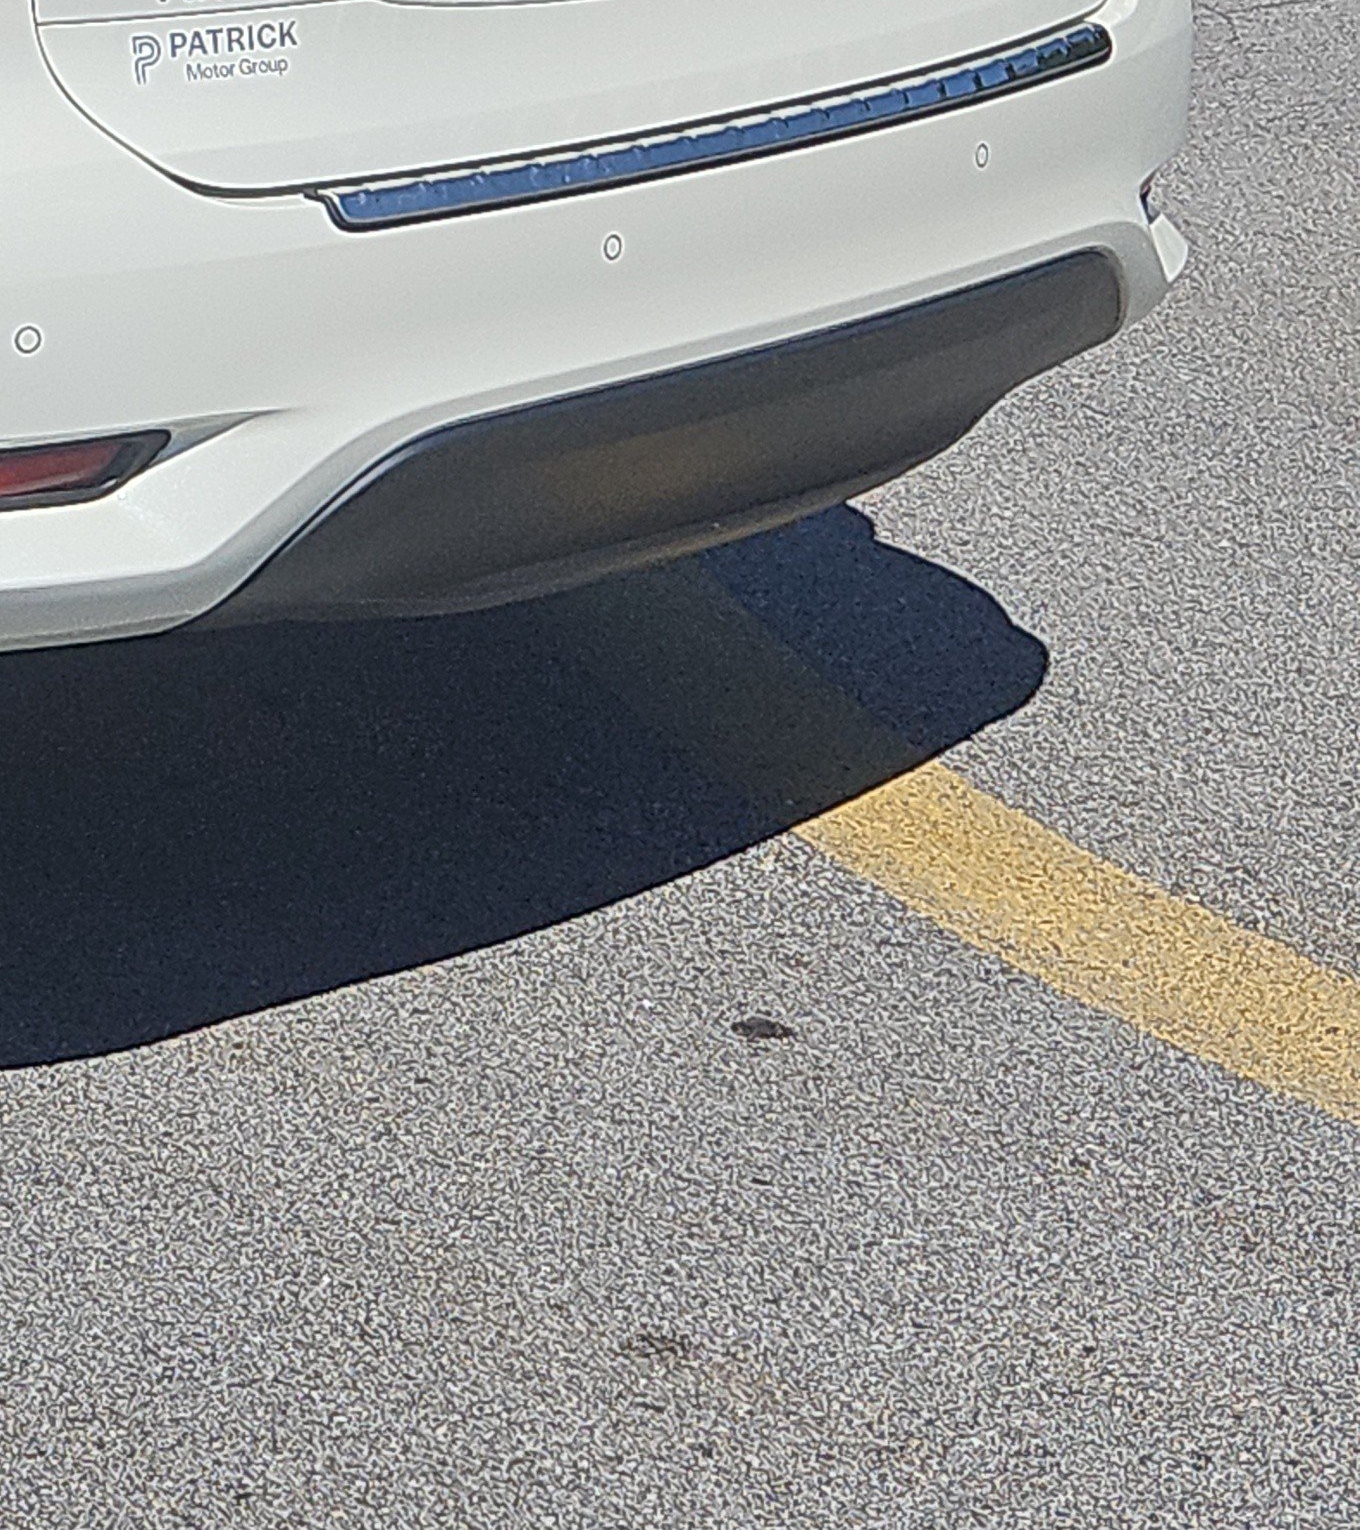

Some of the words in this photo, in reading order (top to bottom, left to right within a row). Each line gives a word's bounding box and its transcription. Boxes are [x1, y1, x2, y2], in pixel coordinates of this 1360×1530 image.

[169, 20, 298, 58] PATRICK
[185, 62, 236, 82] Motor
[238, 57, 289, 77] Group
